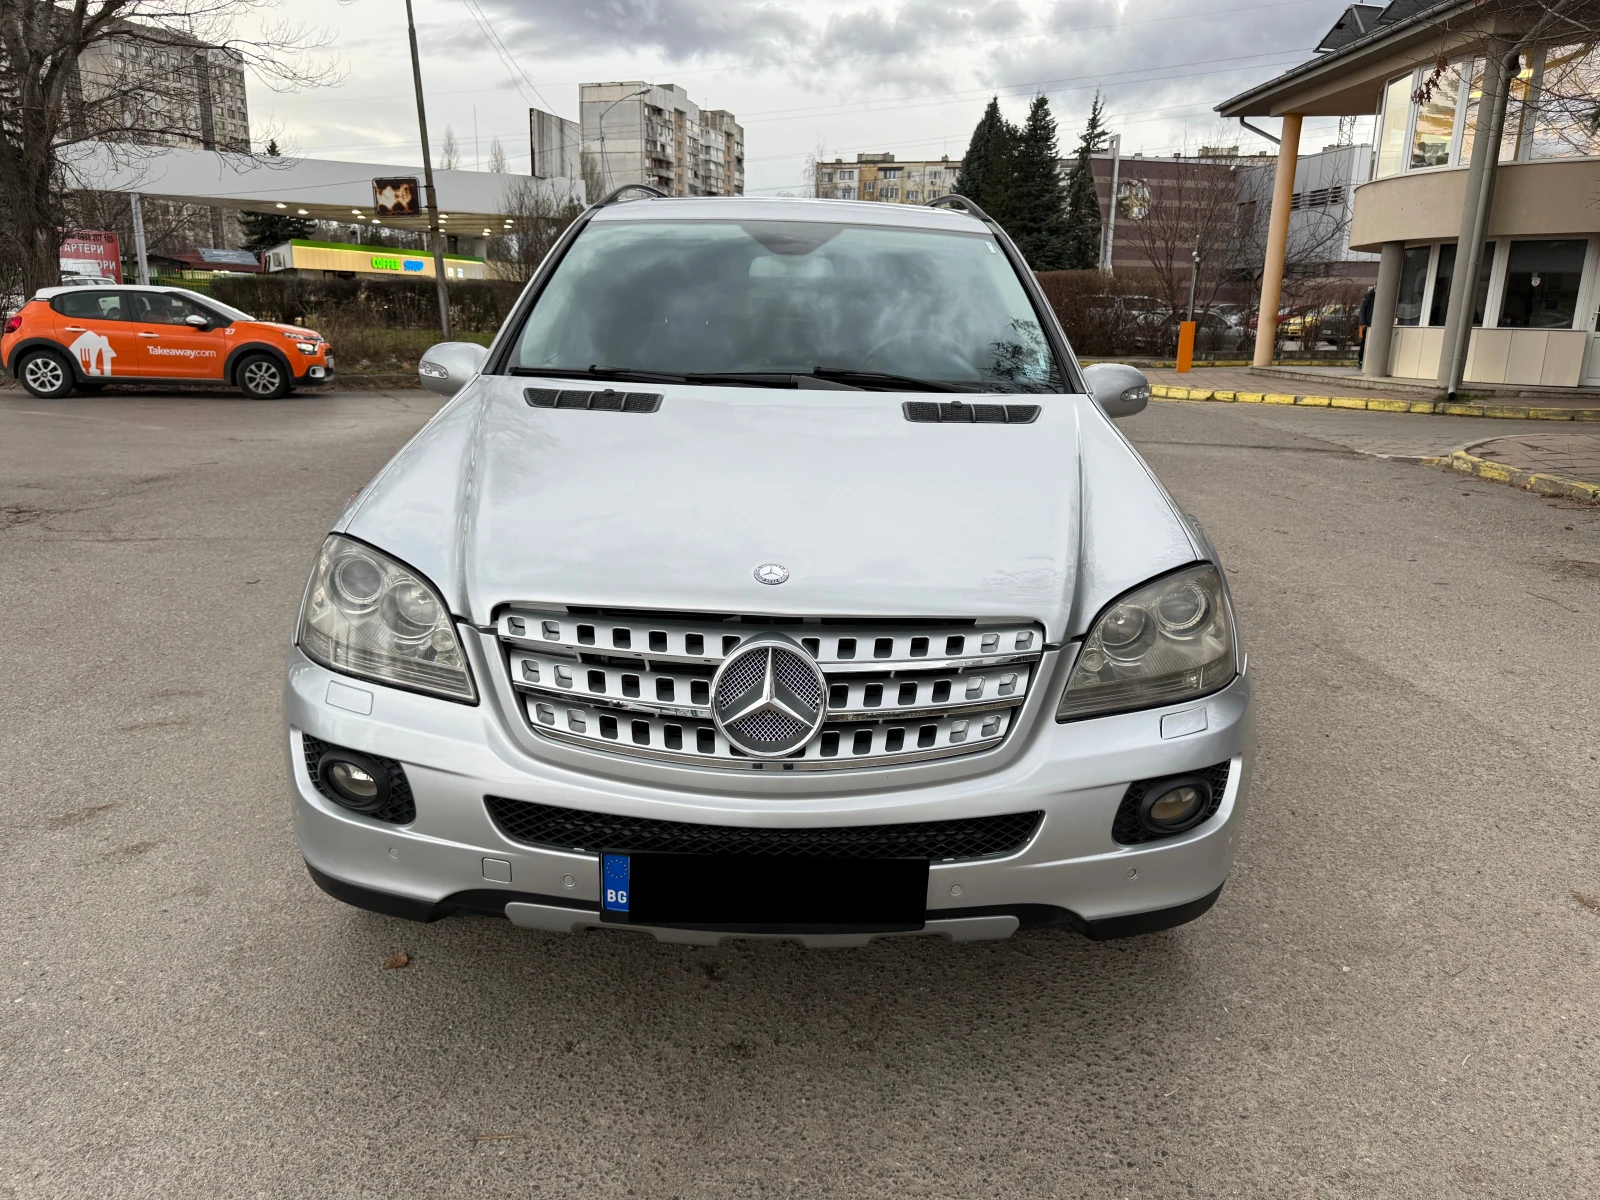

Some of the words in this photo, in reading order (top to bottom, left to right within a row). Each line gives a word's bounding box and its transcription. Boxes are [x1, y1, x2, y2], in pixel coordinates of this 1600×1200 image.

[371, 257, 400, 270] COFFEE
[403, 259, 424, 272] SHOP
[146, 345, 216, 358] Takeaway.com
[607, 889, 627, 904] BG
